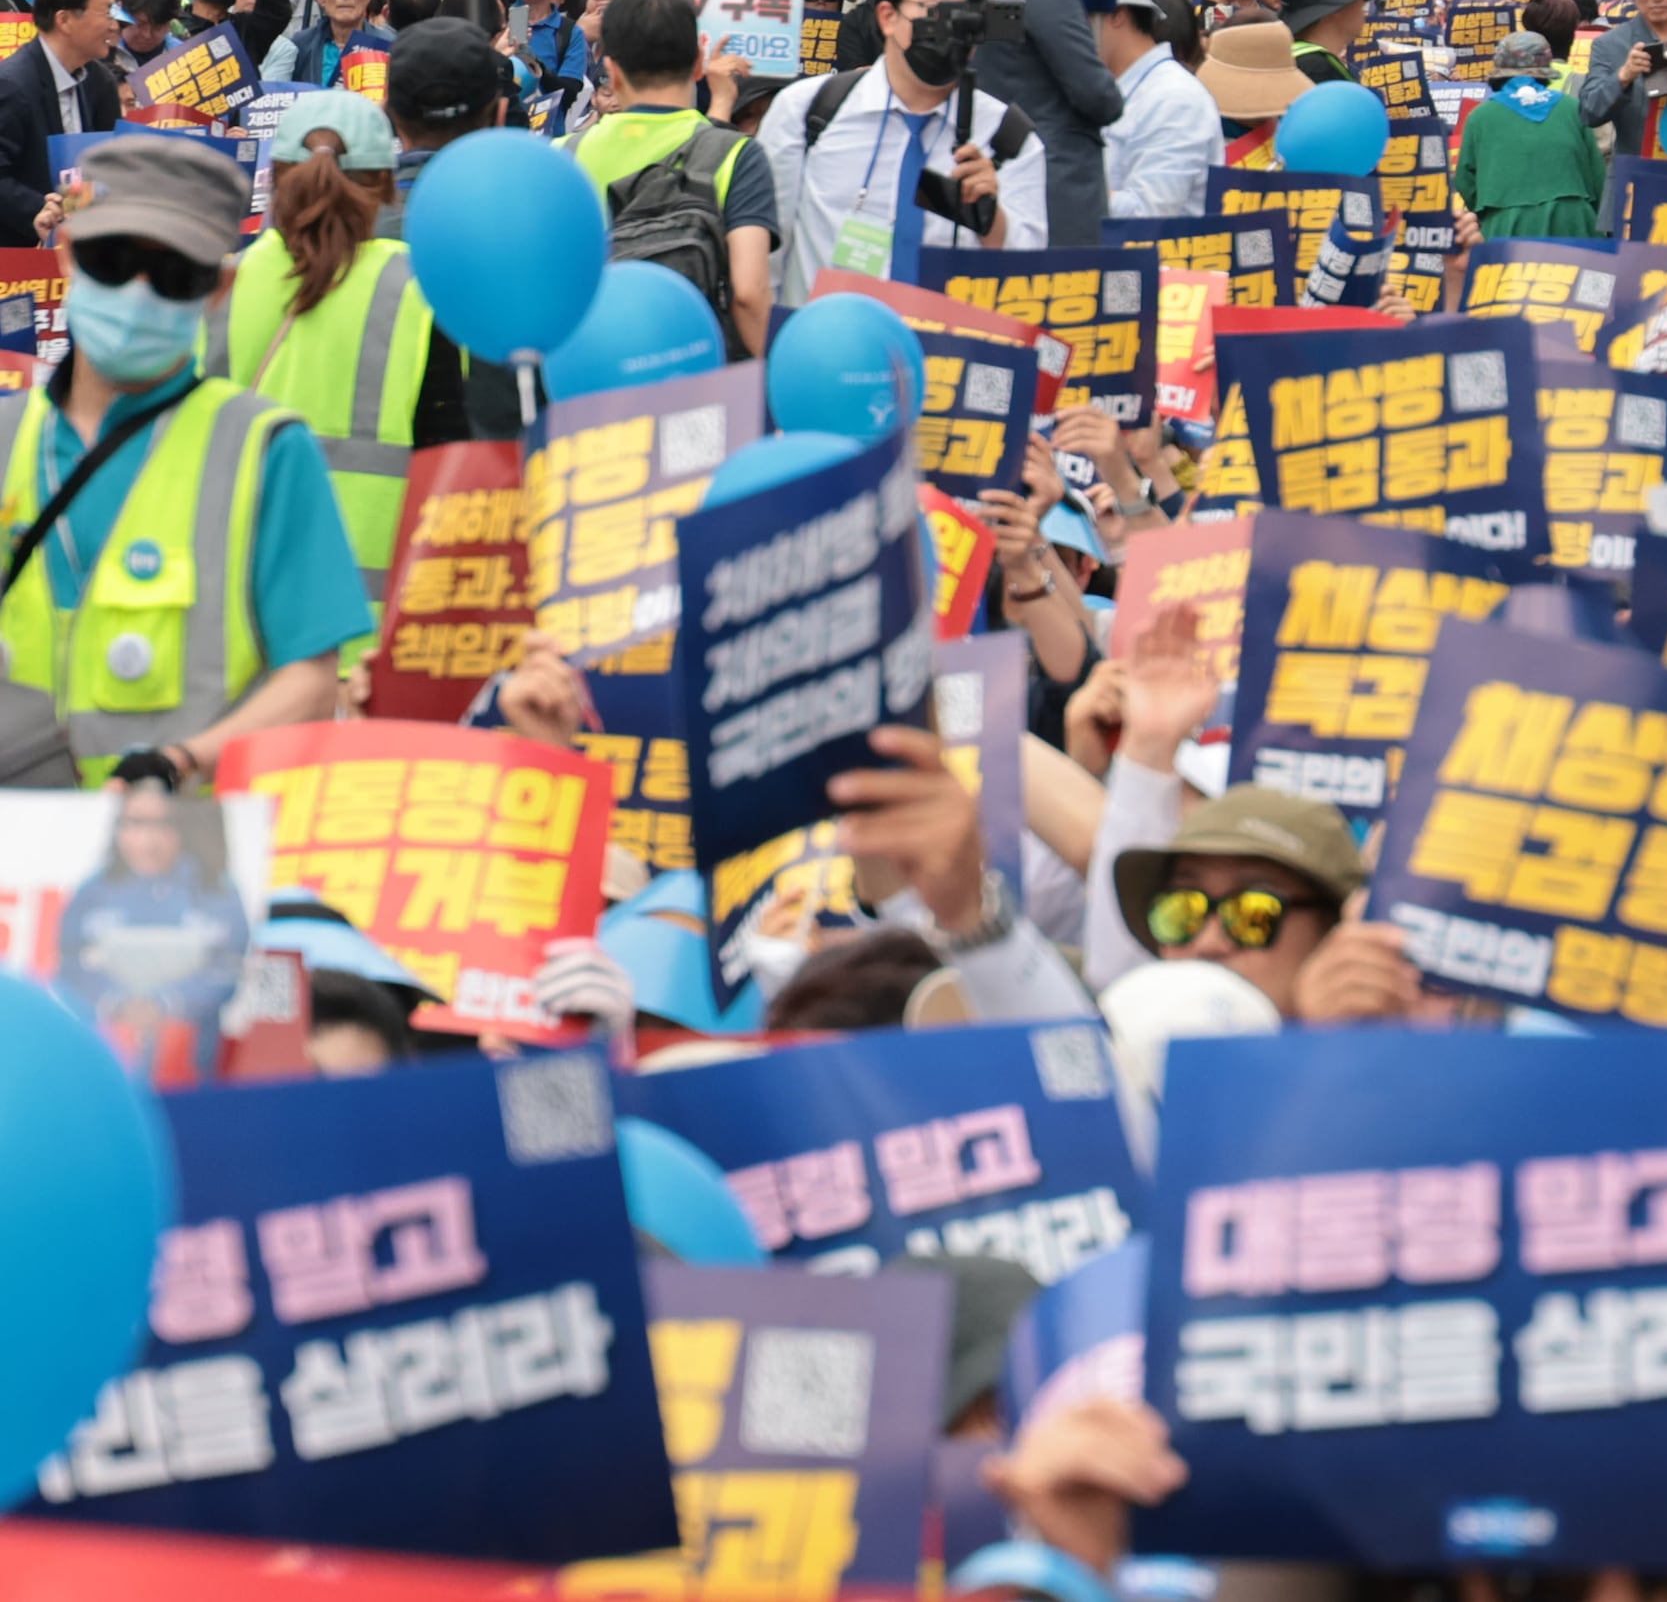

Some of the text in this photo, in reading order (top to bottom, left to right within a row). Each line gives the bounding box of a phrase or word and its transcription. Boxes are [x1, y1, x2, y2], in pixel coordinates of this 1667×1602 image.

[1270, 353, 1444, 451] 채상병
[1382, 415, 1513, 501] 통과
[1408, 789, 1637, 923] 특검
[258, 1175, 485, 1324] 말고
[1183, 1162, 1501, 1296] 대통령
[280, 1281, 612, 1462] 살려라
[1177, 1298, 1499, 1433] 국민을
